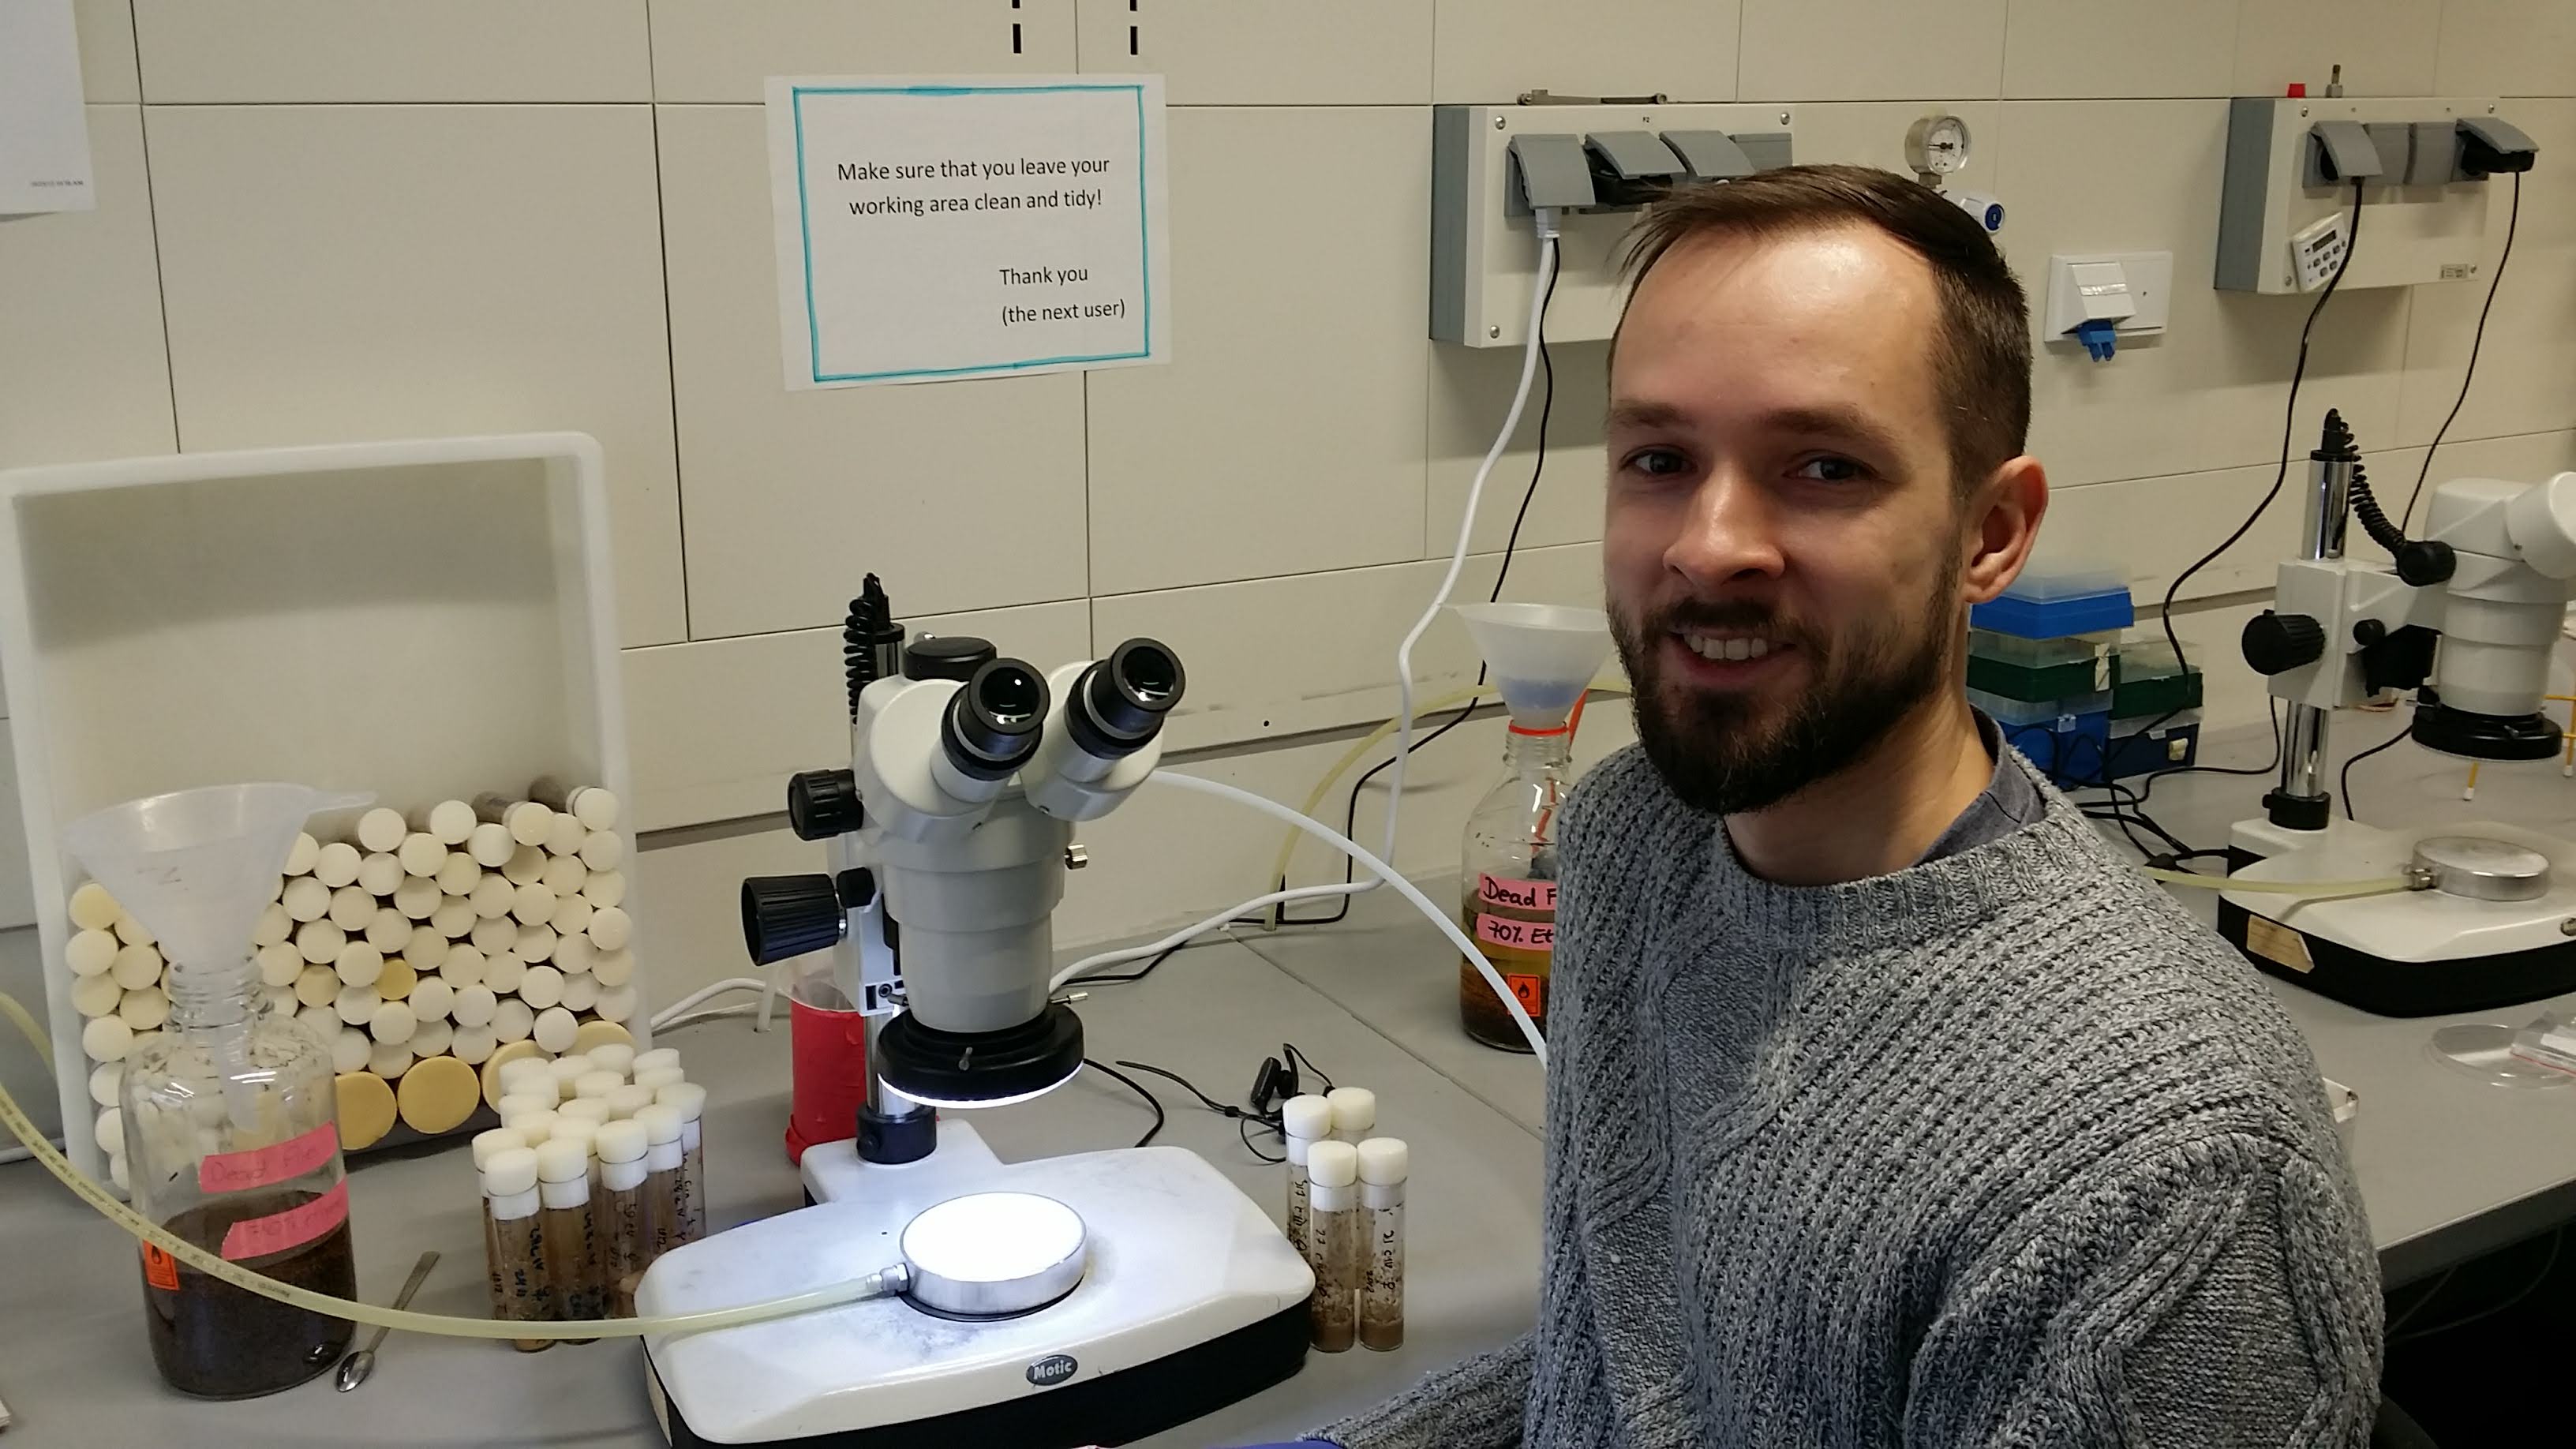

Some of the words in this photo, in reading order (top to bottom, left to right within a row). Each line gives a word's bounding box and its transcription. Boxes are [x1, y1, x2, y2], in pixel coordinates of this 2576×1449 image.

[837, 161, 890, 182] Make
[895, 164, 935, 180] sure
[940, 159, 978, 178] that
[982, 163, 1016, 181] you
[1020, 157, 1067, 176] leave
[1070, 159, 1110, 178] your
[848, 195, 925, 217] working
[929, 198, 969, 212] area
[974, 192, 1021, 211] clean
[1026, 189, 1060, 209] and
[1063, 188, 1103, 209] tidy!
[998, 266, 1053, 286] Thank
[1057, 268, 1089, 285] you
[1002, 305, 1037, 327] (the
[1042, 303, 1080, 320] next
[1084, 298, 1126, 320] user)
[1483, 876, 1536, 907] Dead
[1488, 920, 1524, 942] 70%
[1033, 1359, 1073, 1380] Motic
